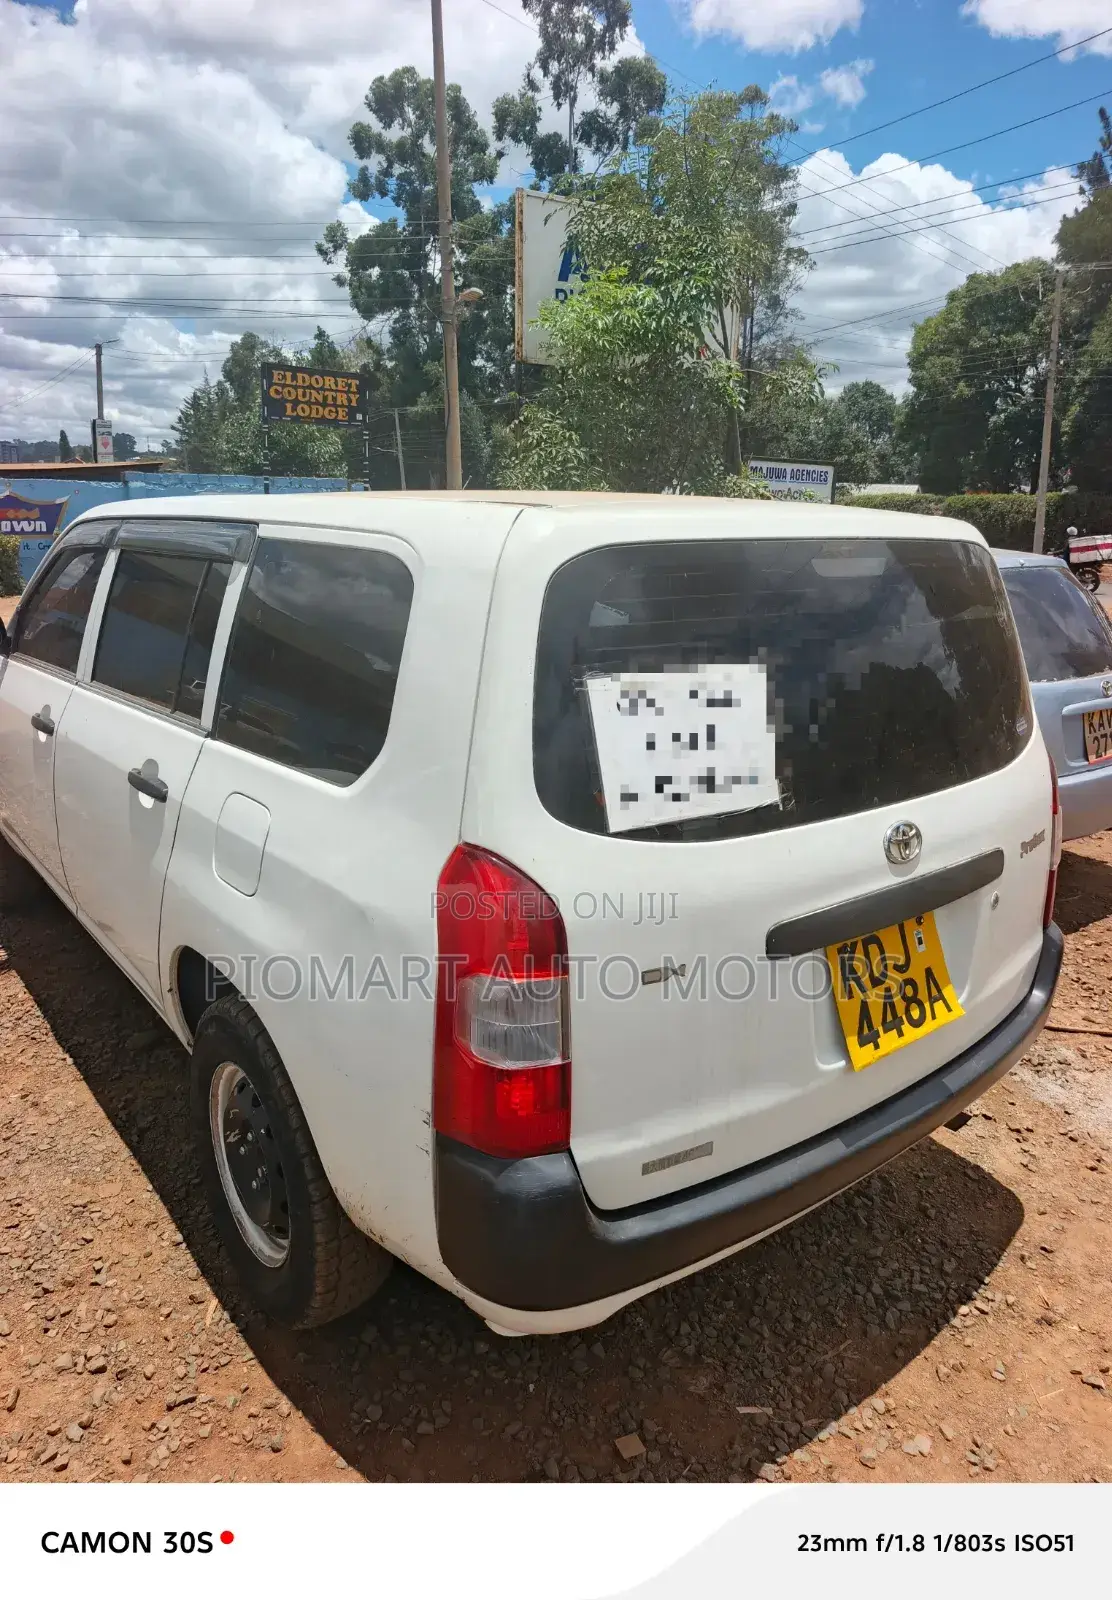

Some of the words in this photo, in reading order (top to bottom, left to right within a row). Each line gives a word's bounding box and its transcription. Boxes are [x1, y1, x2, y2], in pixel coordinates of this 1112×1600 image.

[272, 370, 360, 392] ELDORET
[269, 385, 360, 406] COUNTRY
[285, 402, 349, 420] LODGE
[789, 468, 829, 483] AGENCIES
[837, 922, 911, 999] KDJ
[857, 966, 953, 1050] 448A
